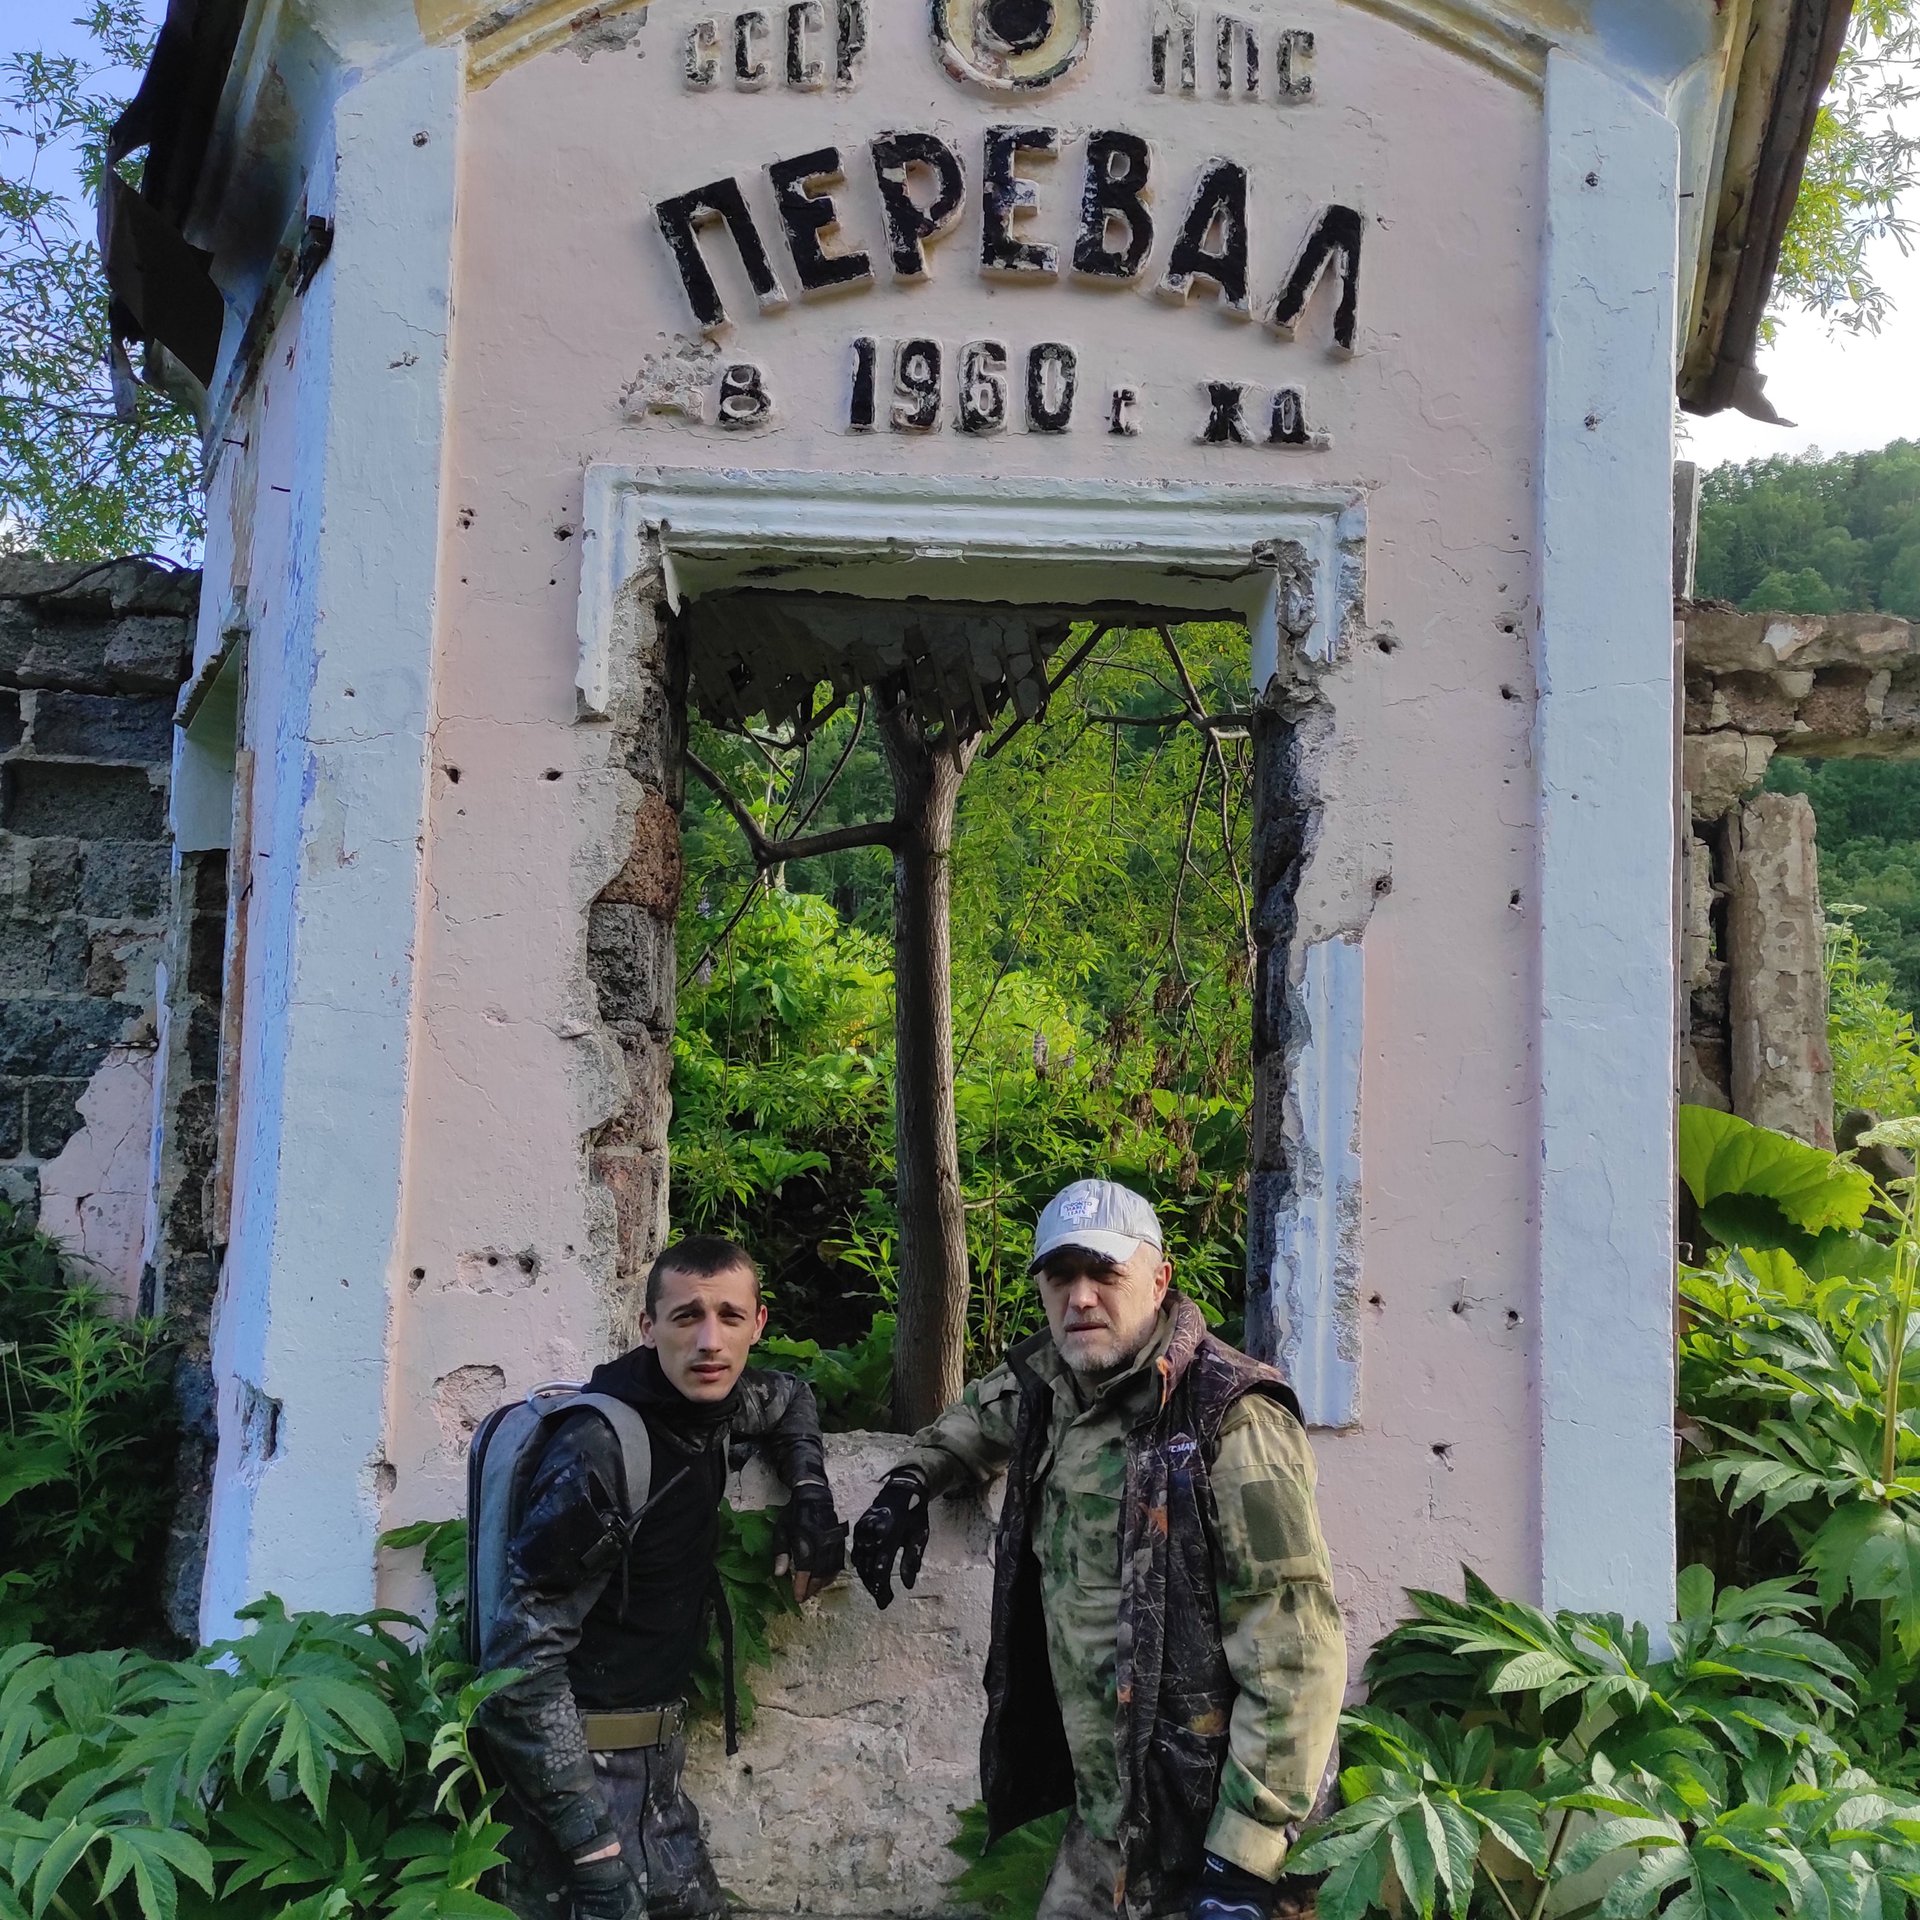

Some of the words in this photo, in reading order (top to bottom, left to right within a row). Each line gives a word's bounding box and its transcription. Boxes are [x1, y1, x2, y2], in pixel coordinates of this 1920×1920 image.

[683, 0, 870, 92] СССР
[650, 124, 1366, 358] ПЕРЕВАЛ
[848, 335, 1079, 434] 1960
